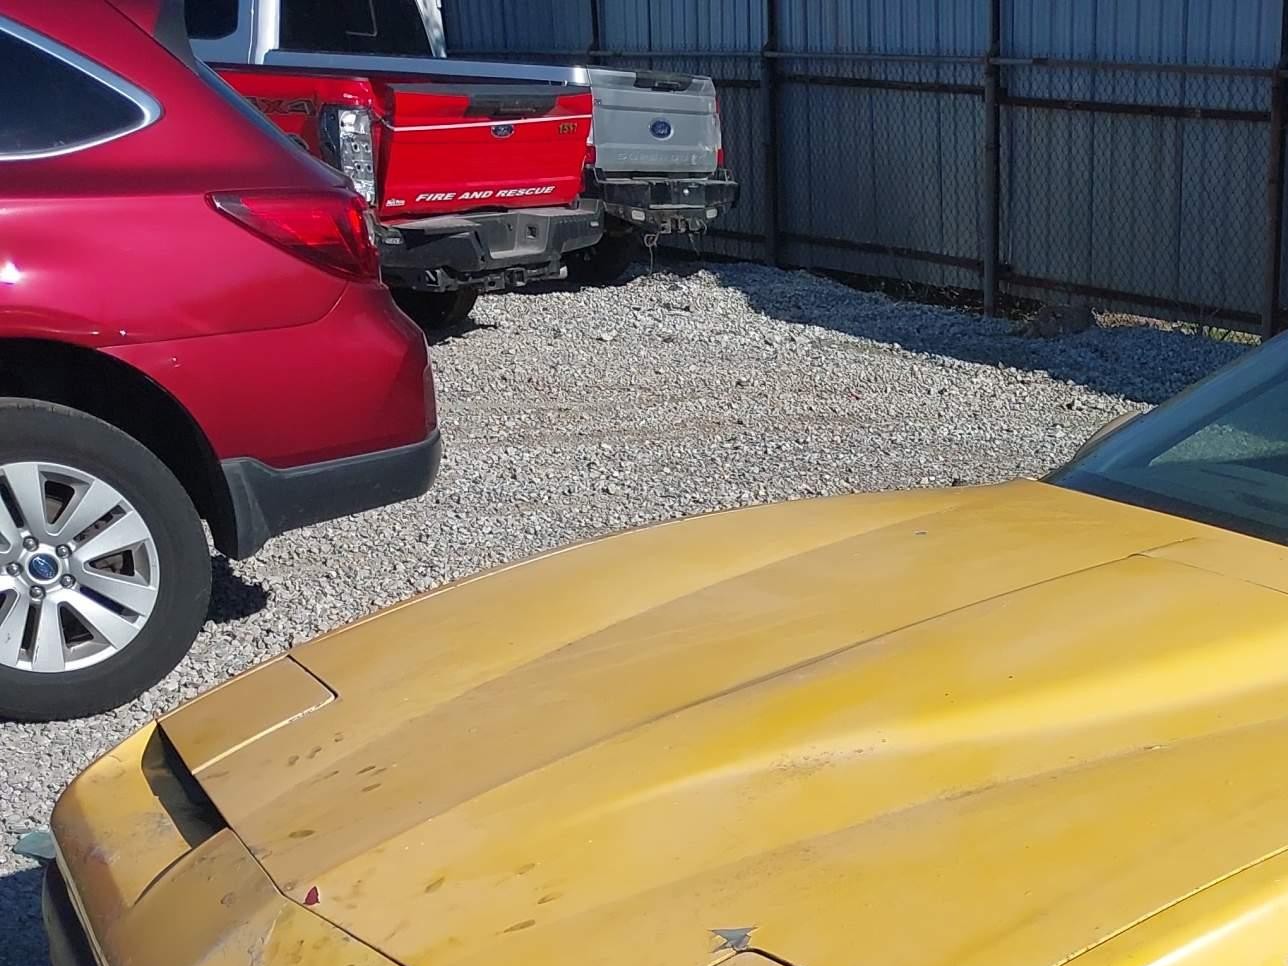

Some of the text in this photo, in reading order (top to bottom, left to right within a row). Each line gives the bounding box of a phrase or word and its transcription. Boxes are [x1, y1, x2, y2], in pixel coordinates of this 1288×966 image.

[416, 186, 556, 202] FIRE AND RESCUE
